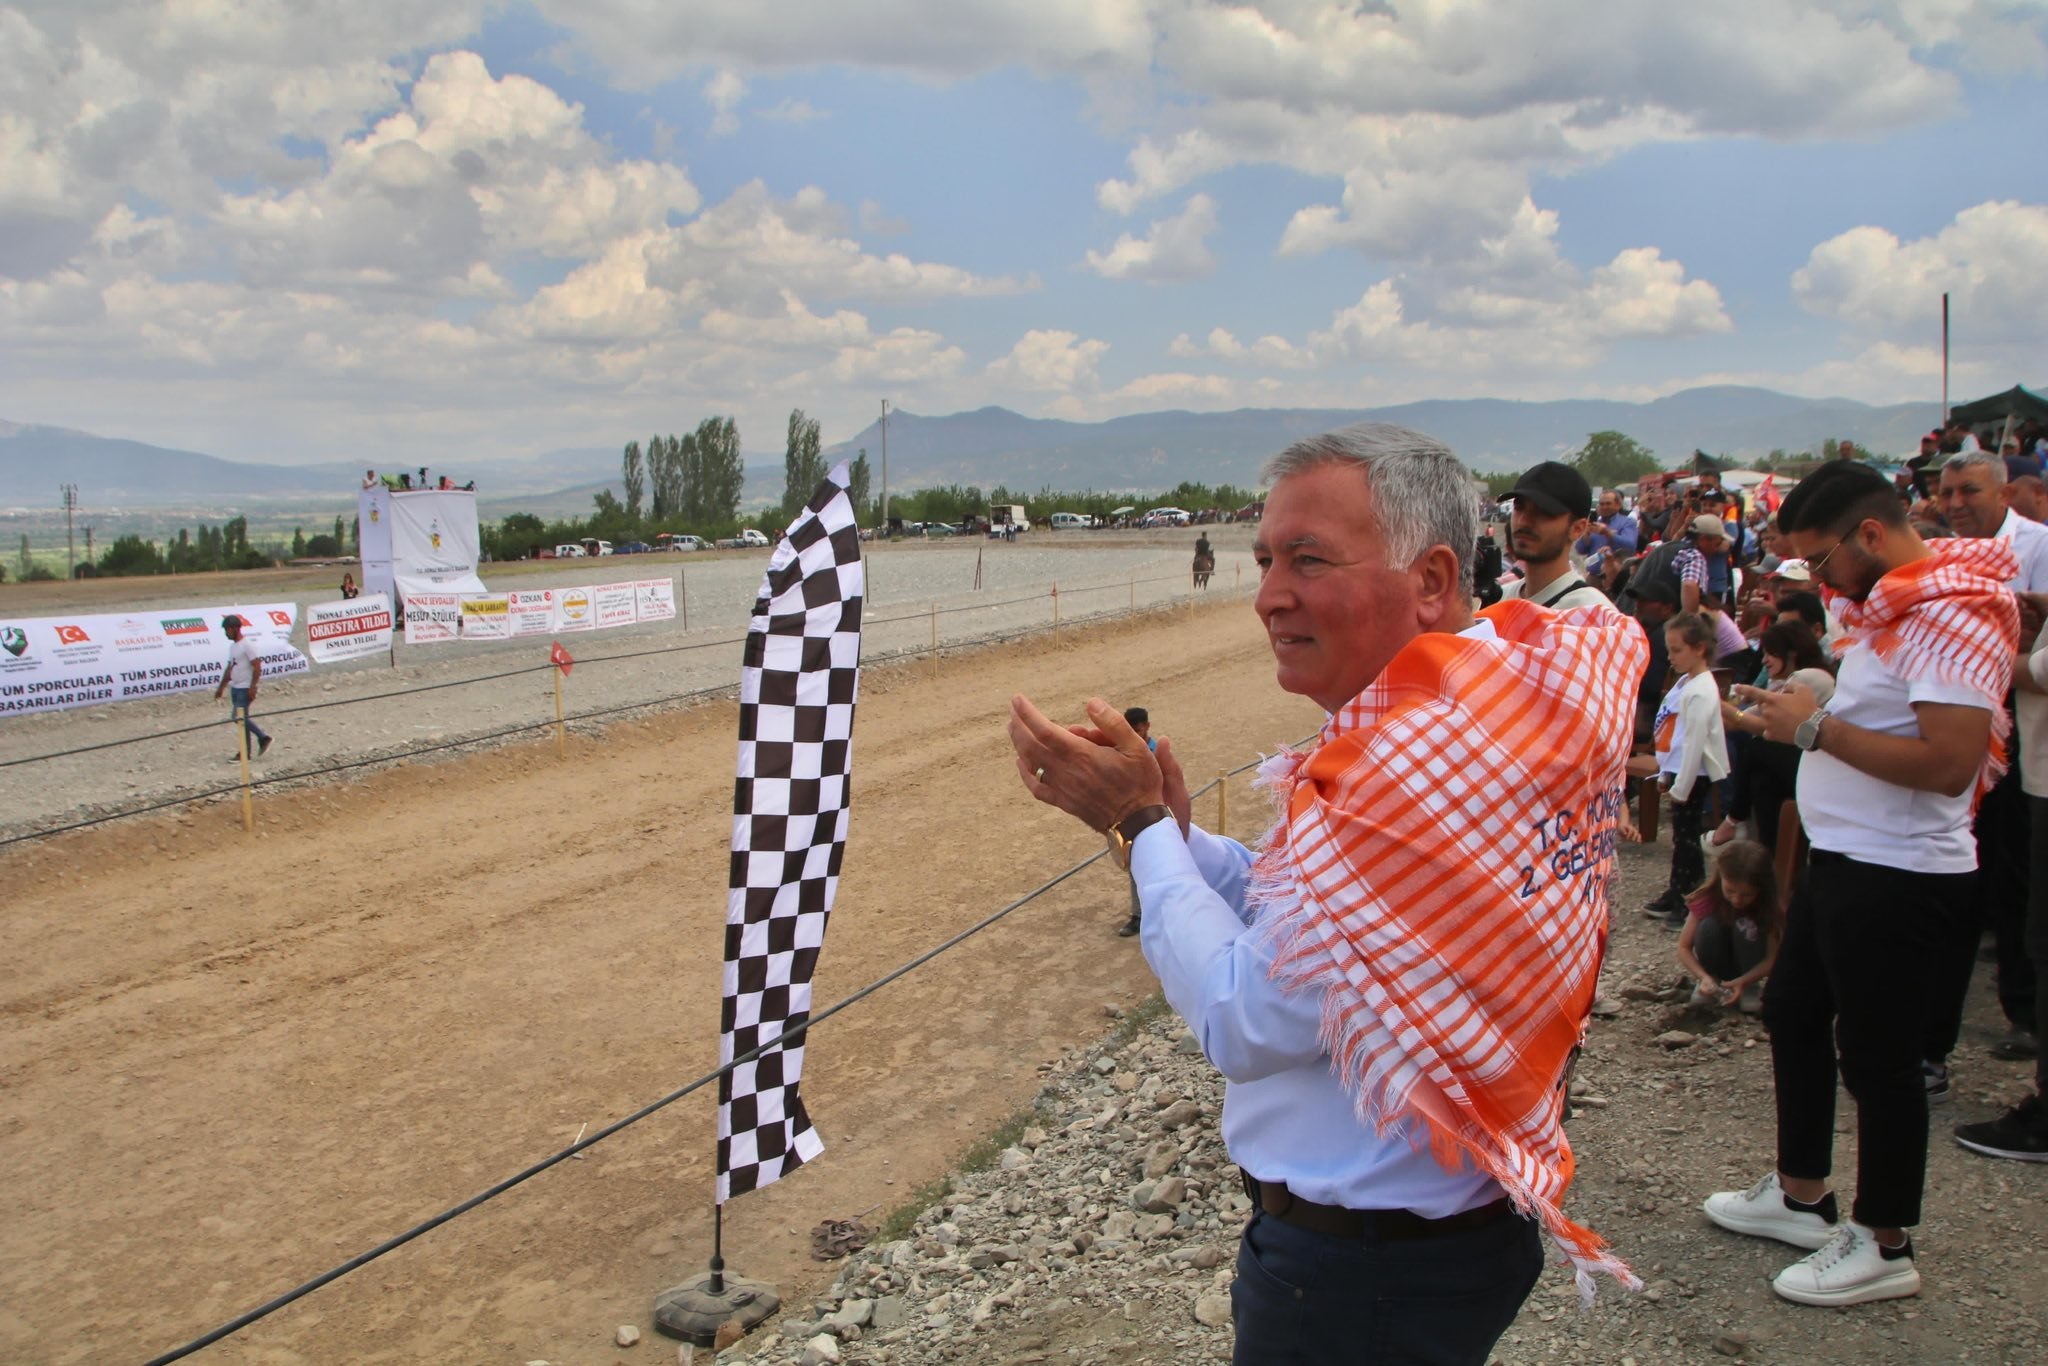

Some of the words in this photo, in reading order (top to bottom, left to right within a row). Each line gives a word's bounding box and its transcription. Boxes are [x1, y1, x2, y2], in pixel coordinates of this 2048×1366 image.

[310, 618, 360, 639] ORKESTRA
[361, 613, 389, 630] YILDIZ
[121, 670, 147, 682] TÜM
[149, 661, 222, 679] SPORCULARA
[28, 674, 114, 694] SPORCULARA
[77, 688, 113, 702] DİLER
[123, 679, 189, 696] BAŞARILAR
[191, 674, 221, 687] DİLER
[1533, 810, 1578, 851] T.C.
[1519, 864, 1542, 899] 2.
